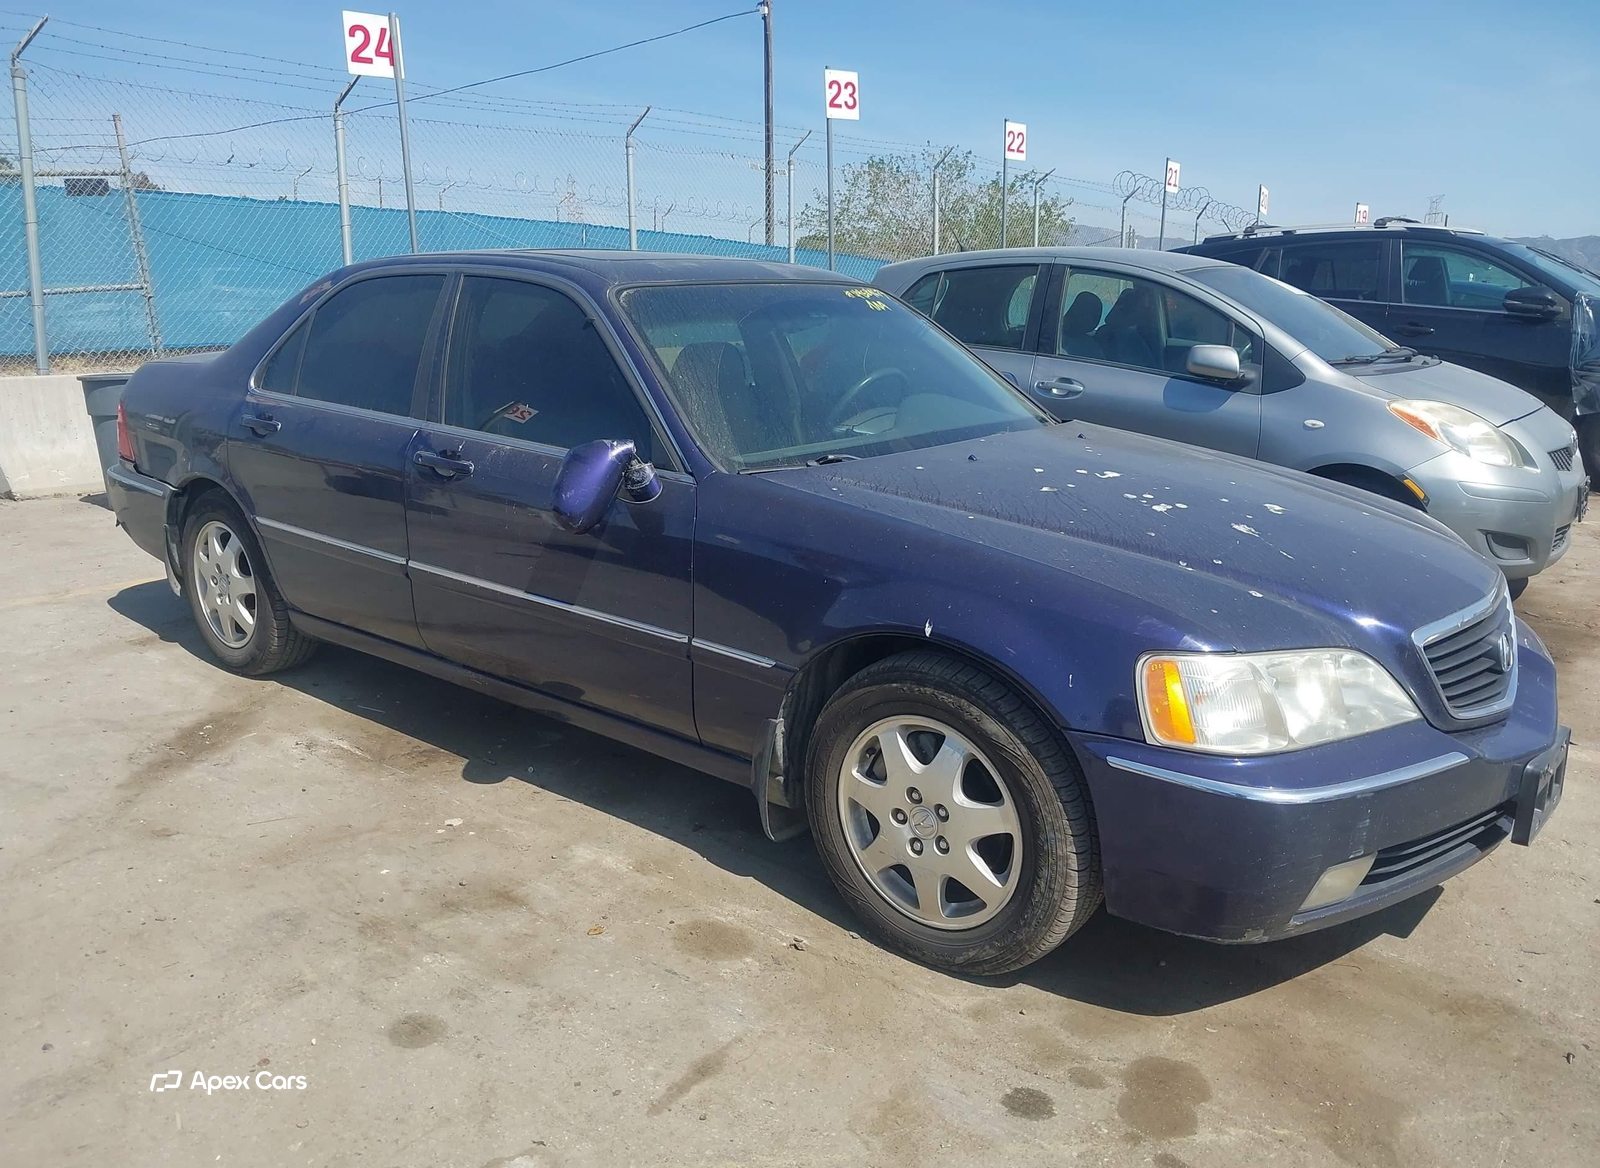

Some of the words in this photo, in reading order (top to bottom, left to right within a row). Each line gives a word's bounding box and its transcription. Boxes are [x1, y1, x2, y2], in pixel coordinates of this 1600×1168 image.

[348, 24, 394, 67] 24
[828, 79, 857, 110] 23
[1007, 130, 1025, 154] 22
[1167, 167, 1178, 188] 21
[1357, 210, 1368, 224] 19
